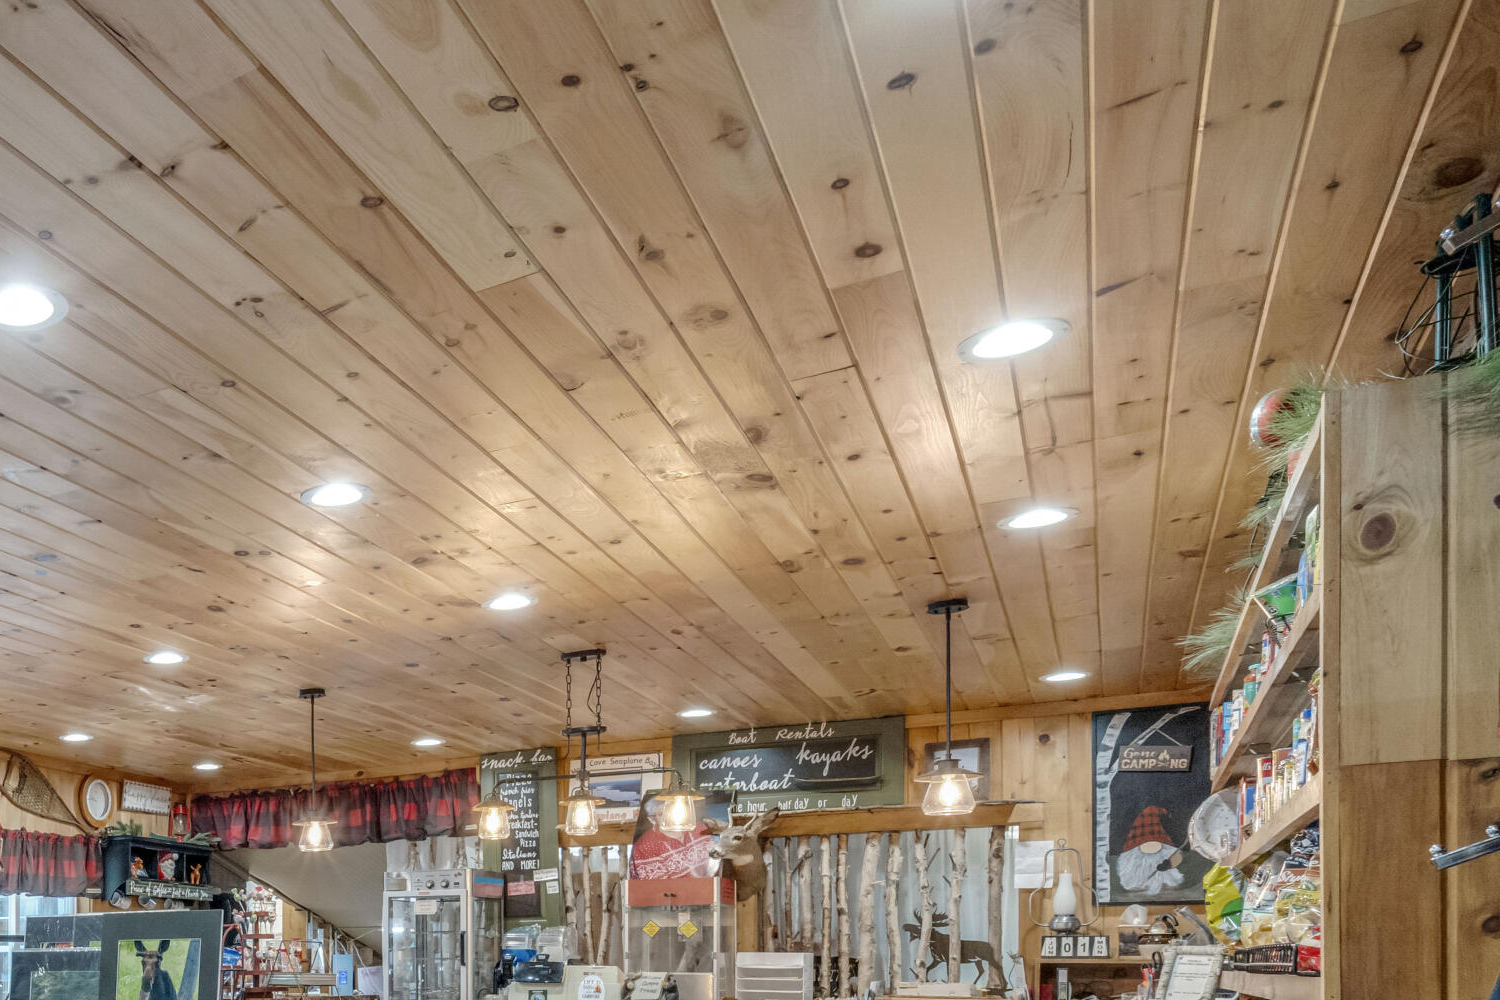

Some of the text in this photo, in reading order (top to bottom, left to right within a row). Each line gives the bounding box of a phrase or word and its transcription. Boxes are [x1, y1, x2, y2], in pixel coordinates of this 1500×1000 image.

[728, 720, 835, 745] Boat Rentals
[531, 749, 554, 765] bar
[699, 738, 874, 776] canoes kayaks
[1123, 747, 1156, 759] Gone
[589, 758, 606, 767] Cove
[610, 757, 643, 767] Seaplane
[794, 797, 810, 810] day
[817, 799, 828, 809] or
[841, 793, 858, 808] day
[509, 818, 538, 831] reakfast-
[502, 847, 537, 860] Italians
